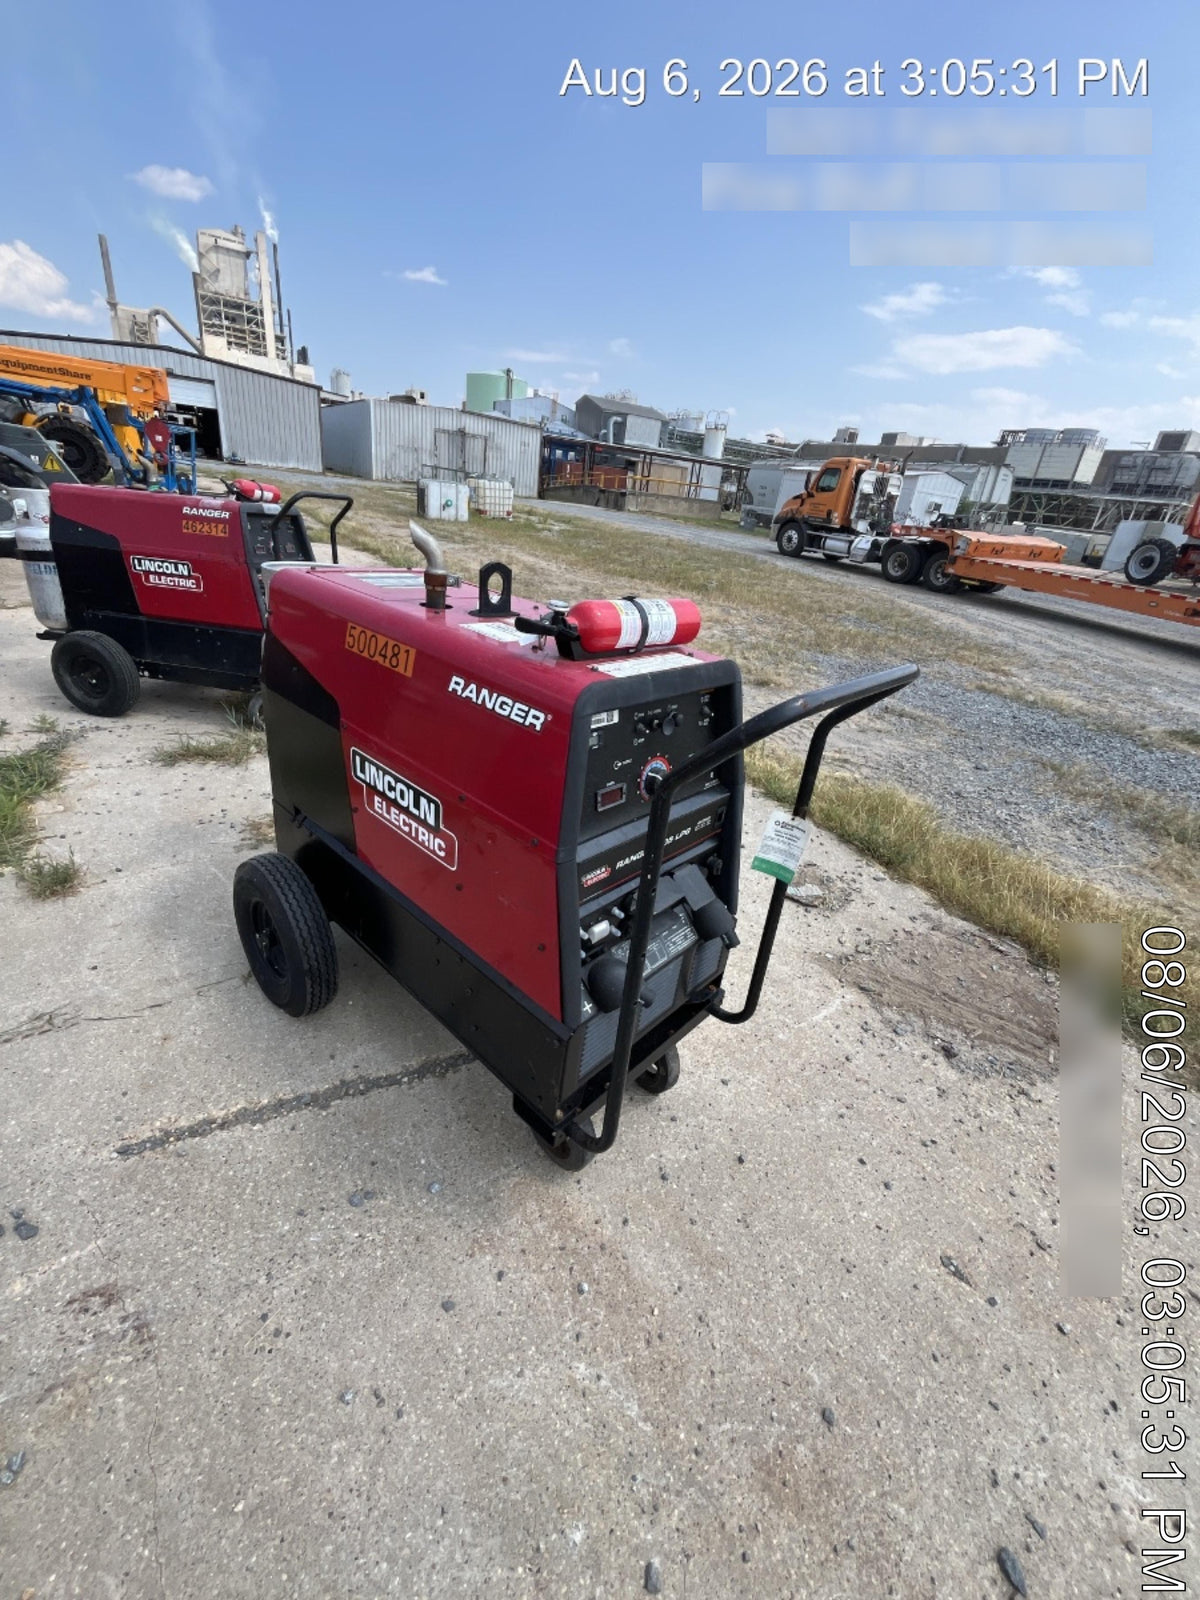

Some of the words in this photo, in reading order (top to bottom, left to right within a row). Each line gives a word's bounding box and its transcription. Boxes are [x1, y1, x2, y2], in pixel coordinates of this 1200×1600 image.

[182, 506, 231, 519] RANGER
[183, 521, 228, 535] 462314
[134, 558, 189, 576] LINCOLN
[149, 574, 197, 589] ELECTRIC
[346, 625, 411, 674] 500481
[355, 754, 436, 828] LINCOLN
[373, 794, 446, 858] ELECTRIC
